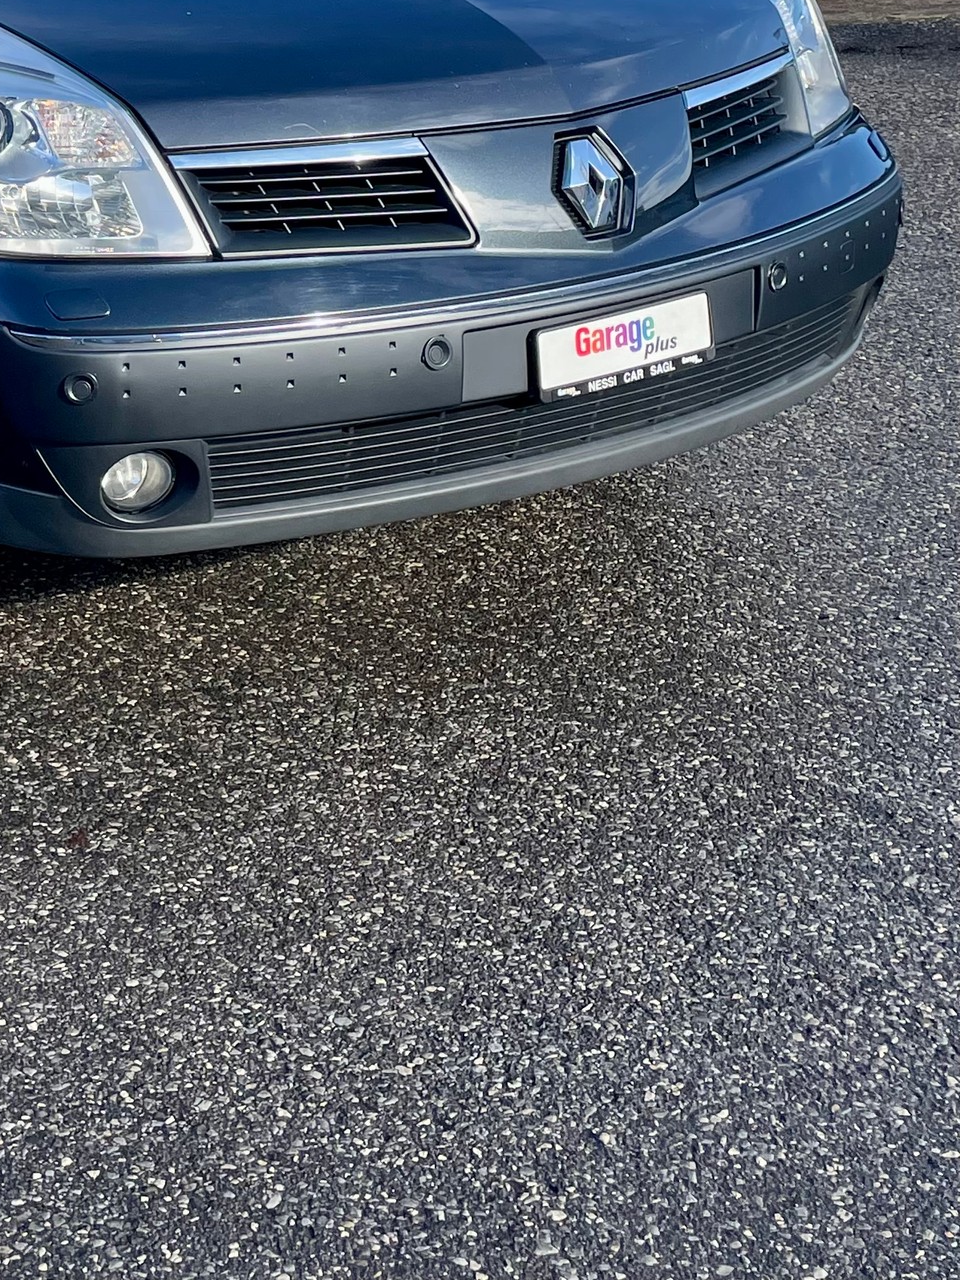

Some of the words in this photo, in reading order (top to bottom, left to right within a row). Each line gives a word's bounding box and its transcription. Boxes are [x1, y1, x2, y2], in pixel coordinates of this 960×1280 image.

[574, 316, 655, 357] Garage
[644, 335, 678, 359] plus
[588, 376, 618, 393] NESSI
[623, 368, 644, 383] CAR
[650, 360, 676, 376] SAGL
